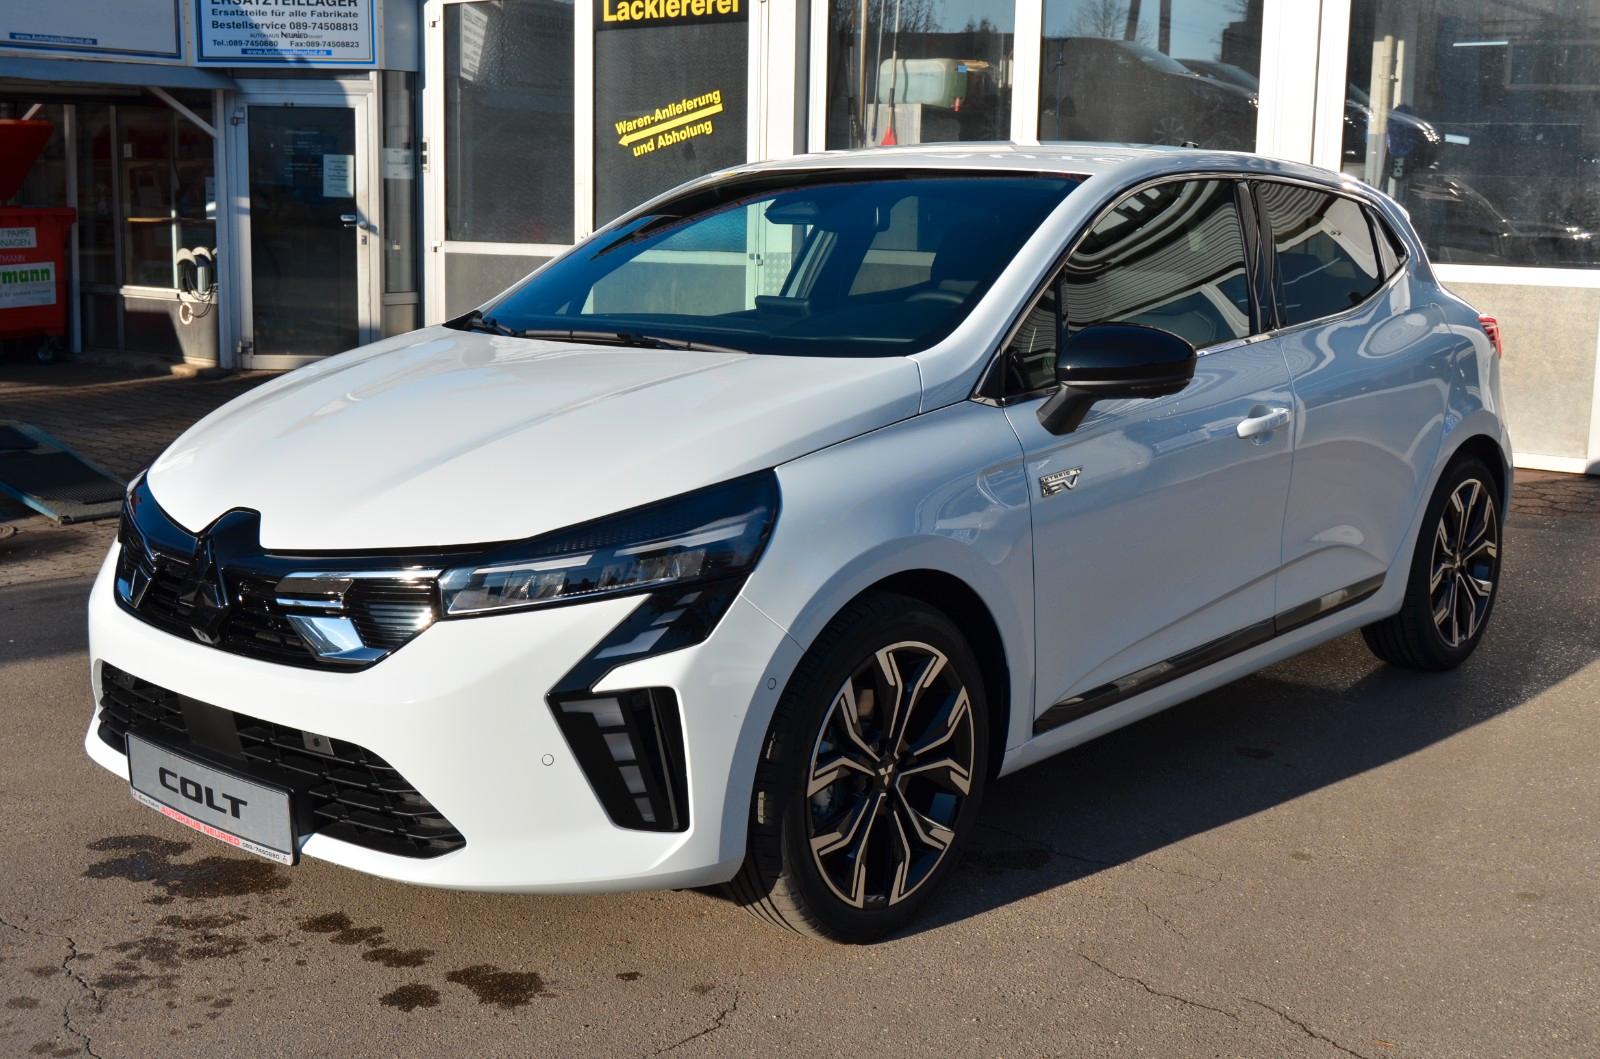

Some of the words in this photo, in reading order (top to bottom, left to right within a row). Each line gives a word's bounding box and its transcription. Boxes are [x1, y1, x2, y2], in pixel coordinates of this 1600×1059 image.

[211, 8, 268, 17] Ersatzteile
[271, 8, 286, 17] für
[289, 9, 307, 18] alle
[310, 10, 359, 18] Fabrikate
[603, 0, 739, 22] Lackiererei
[211, 20, 286, 30] Bestellservice
[289, 21, 359, 31] 089-74508813
[615, 90, 721, 135] Waren-Anlieferung
[633, 139, 655, 157] und
[657, 120, 713, 149] Abholung
[0, 268, 50, 285] mann
[1043, 474, 1078, 497] EV
[158, 766, 248, 820] COLT
[159, 806, 201, 831] AUTOHAUS
[203, 823, 241, 846] NEURIED
